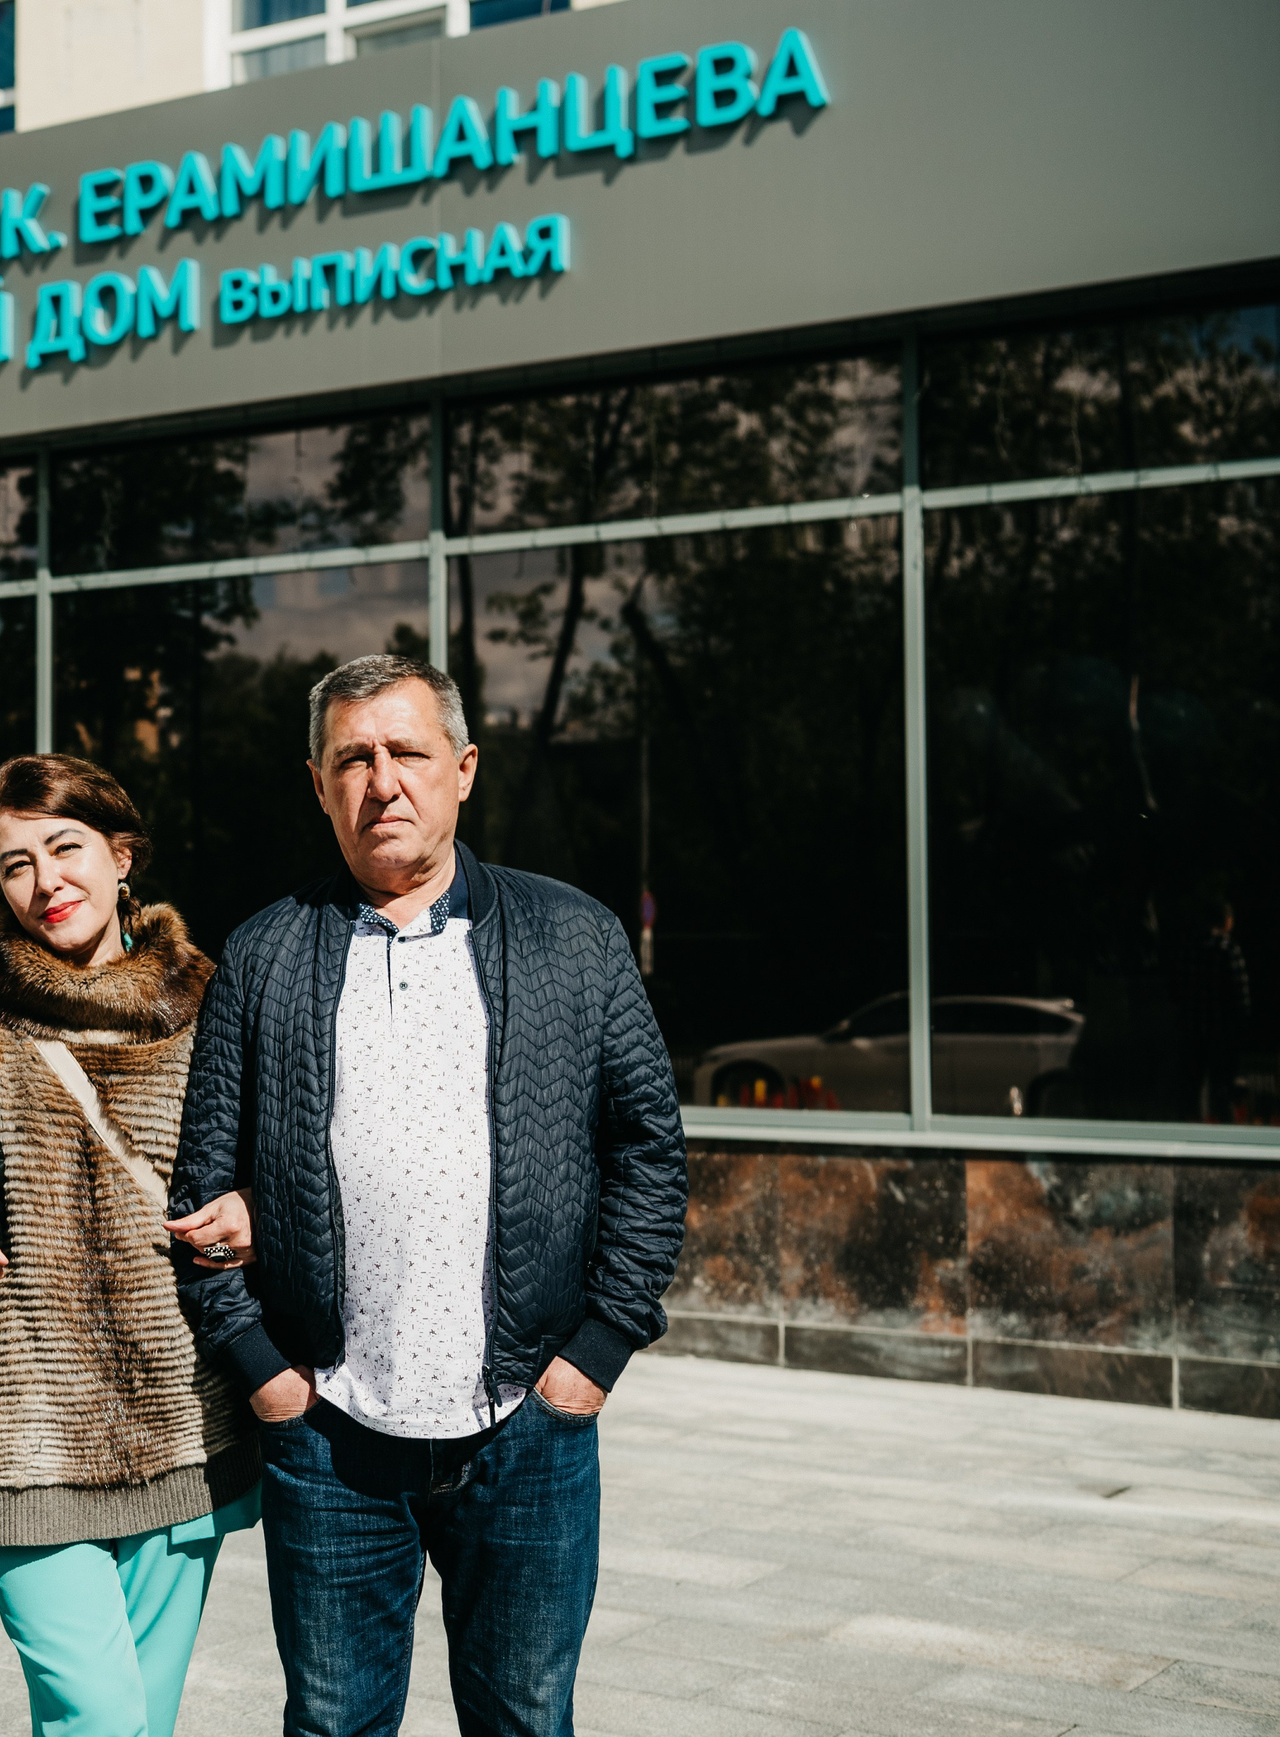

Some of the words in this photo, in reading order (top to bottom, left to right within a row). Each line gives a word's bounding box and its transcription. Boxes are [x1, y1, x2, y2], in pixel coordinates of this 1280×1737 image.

[78, 27, 831, 243] ЕРАМИШАНЦЕВА
[25, 258, 199, 369] ДОМ
[219, 212, 570, 324] ВЫПИСНАЯ
